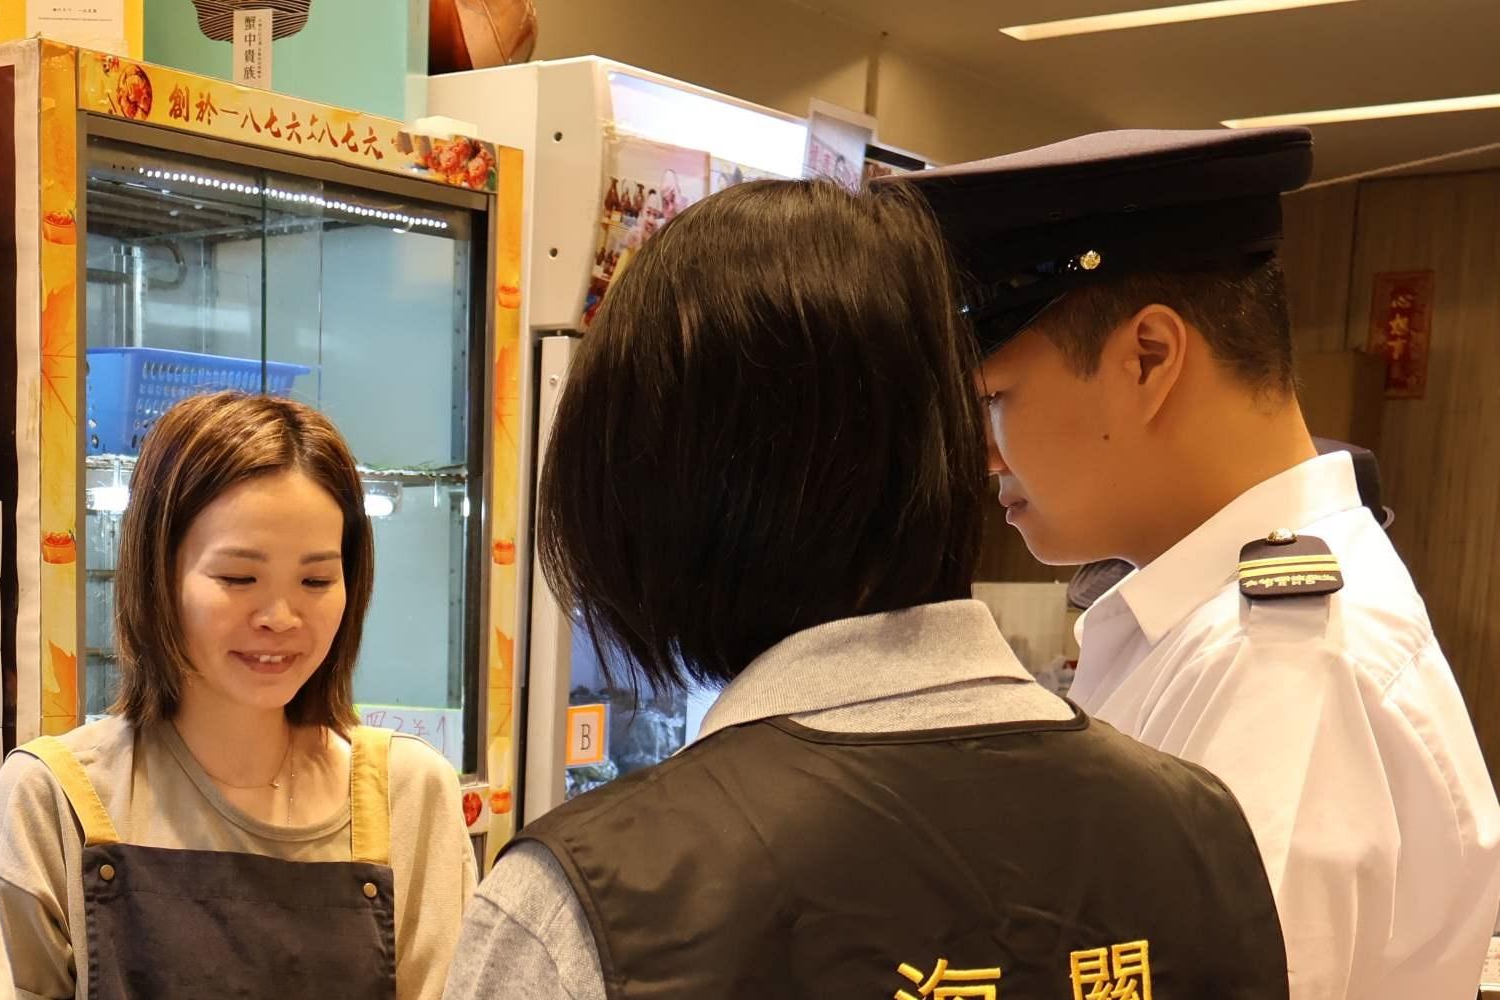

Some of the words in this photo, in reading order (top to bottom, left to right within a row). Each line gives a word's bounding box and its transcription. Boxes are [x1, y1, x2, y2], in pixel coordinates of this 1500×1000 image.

[244, 15, 256, 80] 蟹中貴族
[580, 724, 591, 751] B
